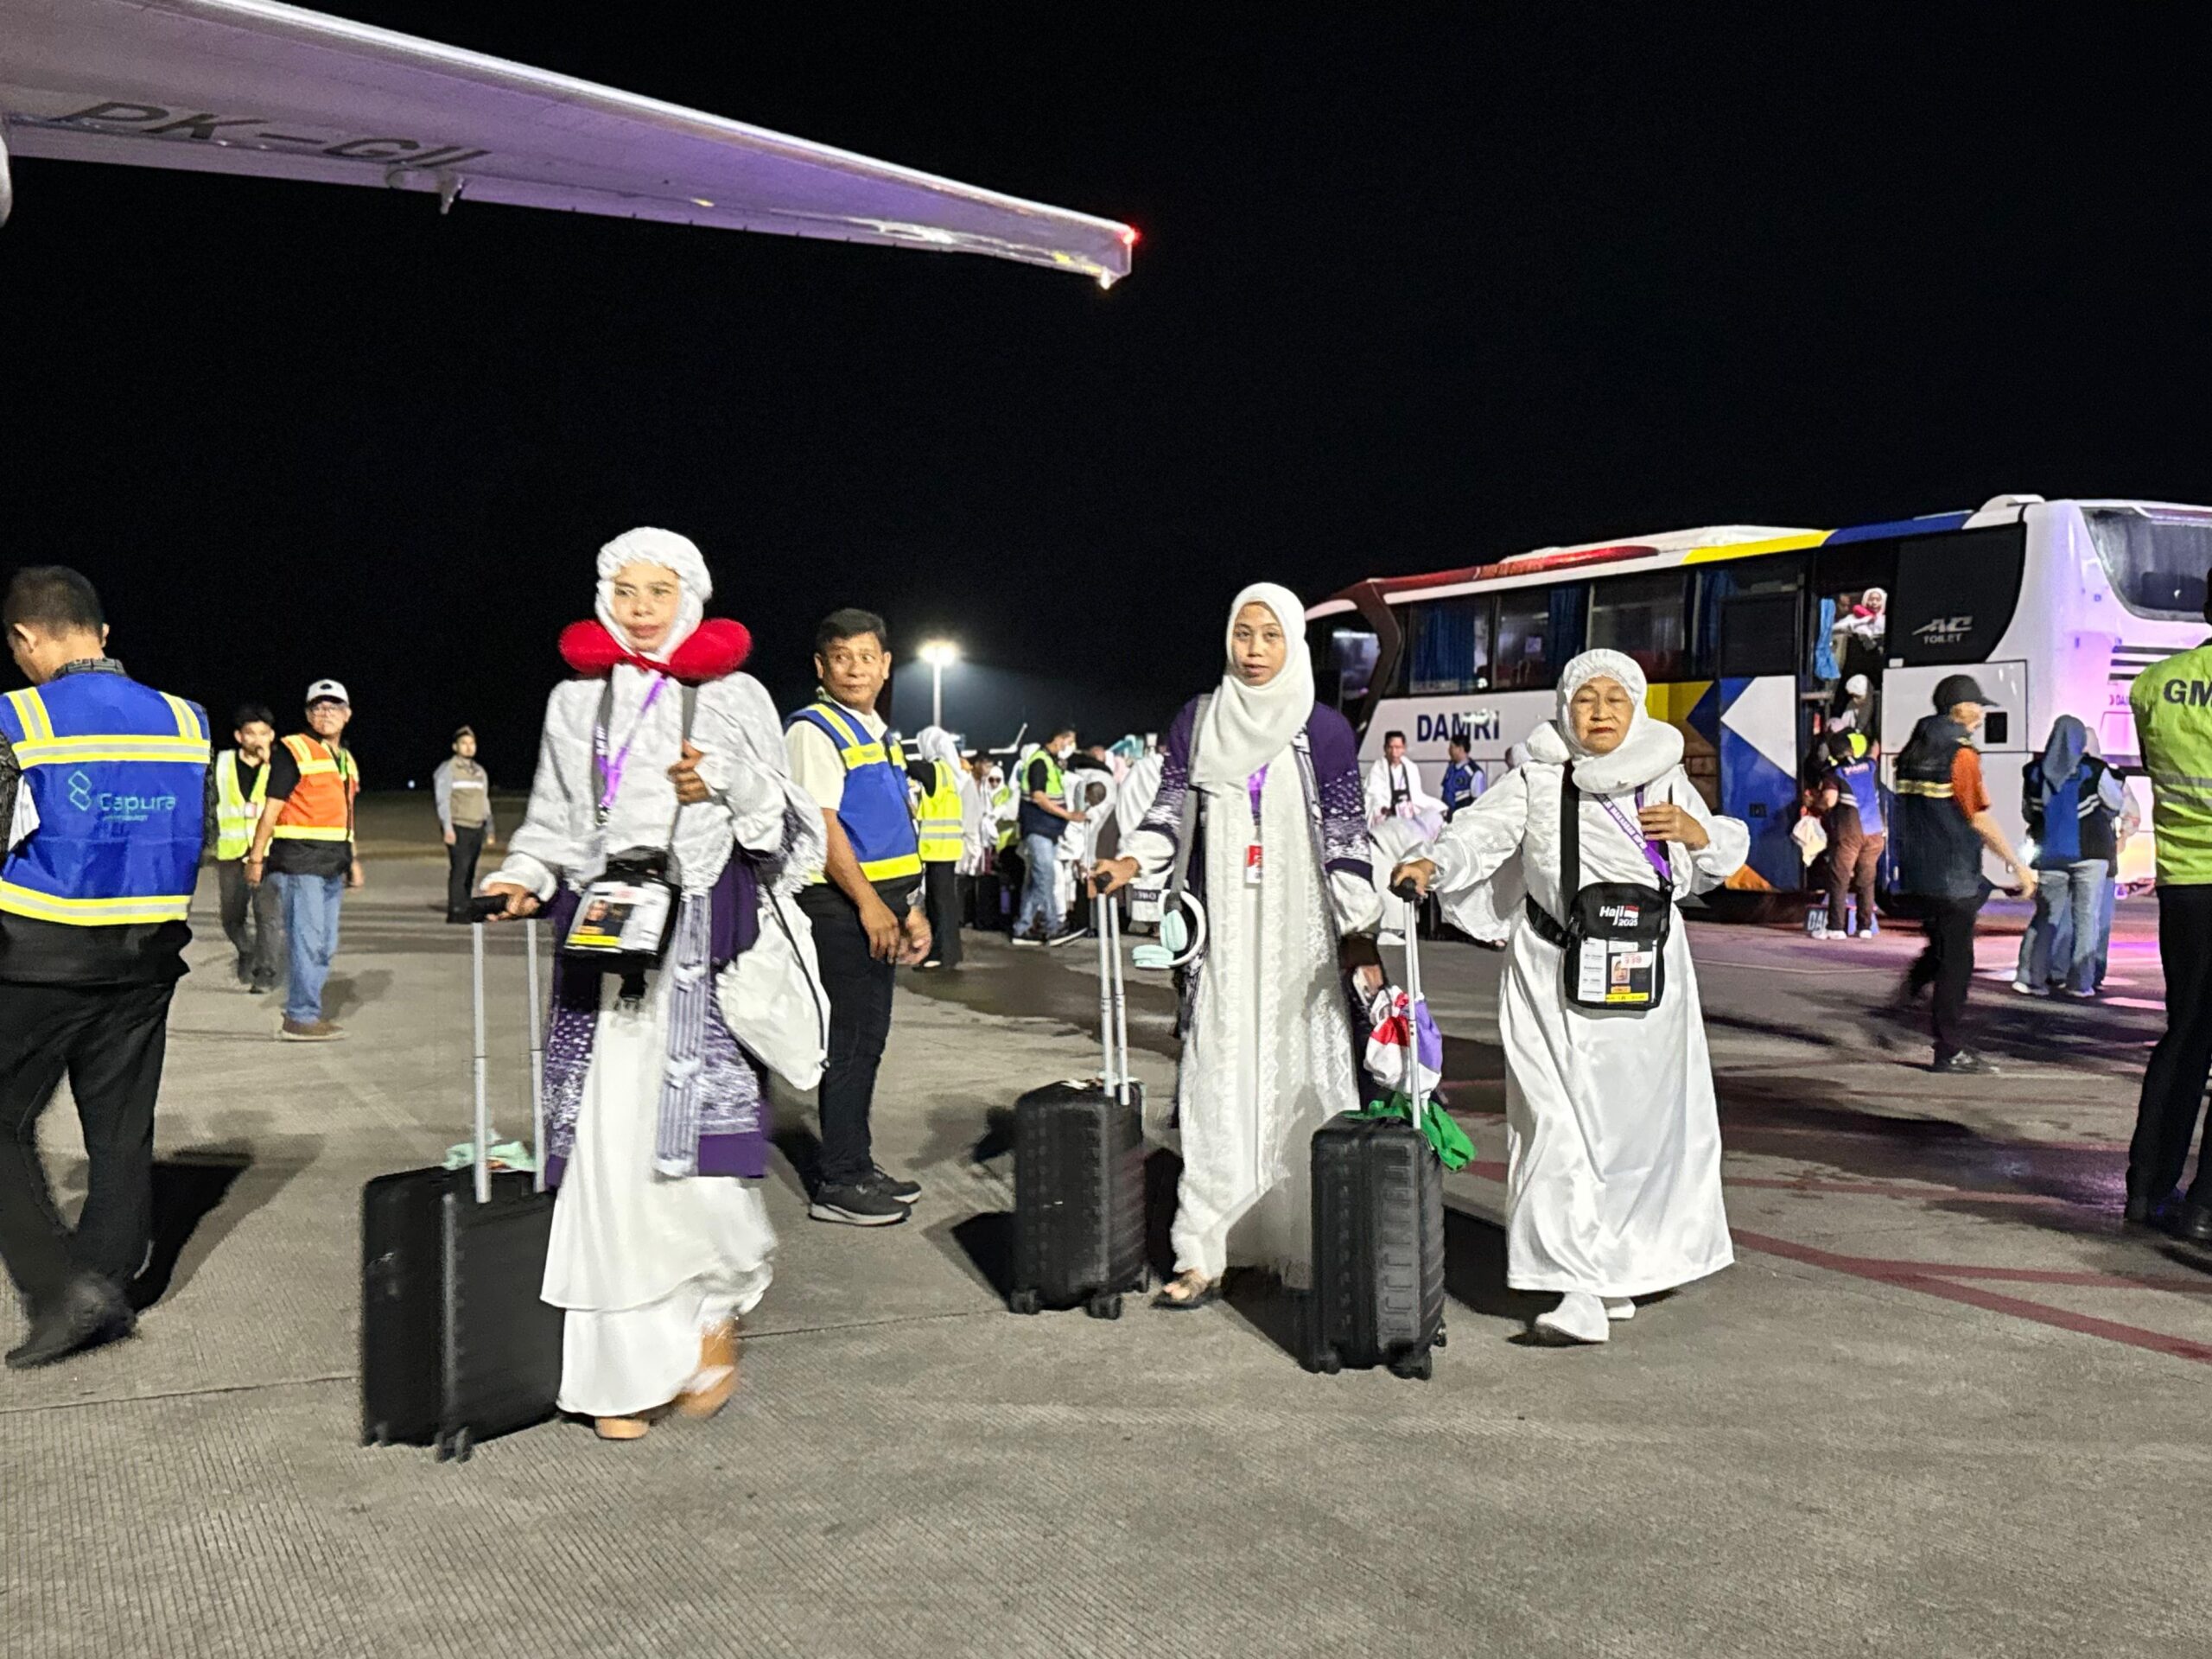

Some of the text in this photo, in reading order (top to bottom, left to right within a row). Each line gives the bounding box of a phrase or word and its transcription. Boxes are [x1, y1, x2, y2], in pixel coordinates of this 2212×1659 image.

[1911, 616, 1973, 635] AC
[1923, 632, 1961, 644] TOILET
[1417, 710, 1499, 741] DAMRI
[1599, 906, 1624, 925] Haji
[1618, 918, 1638, 927] 2025
